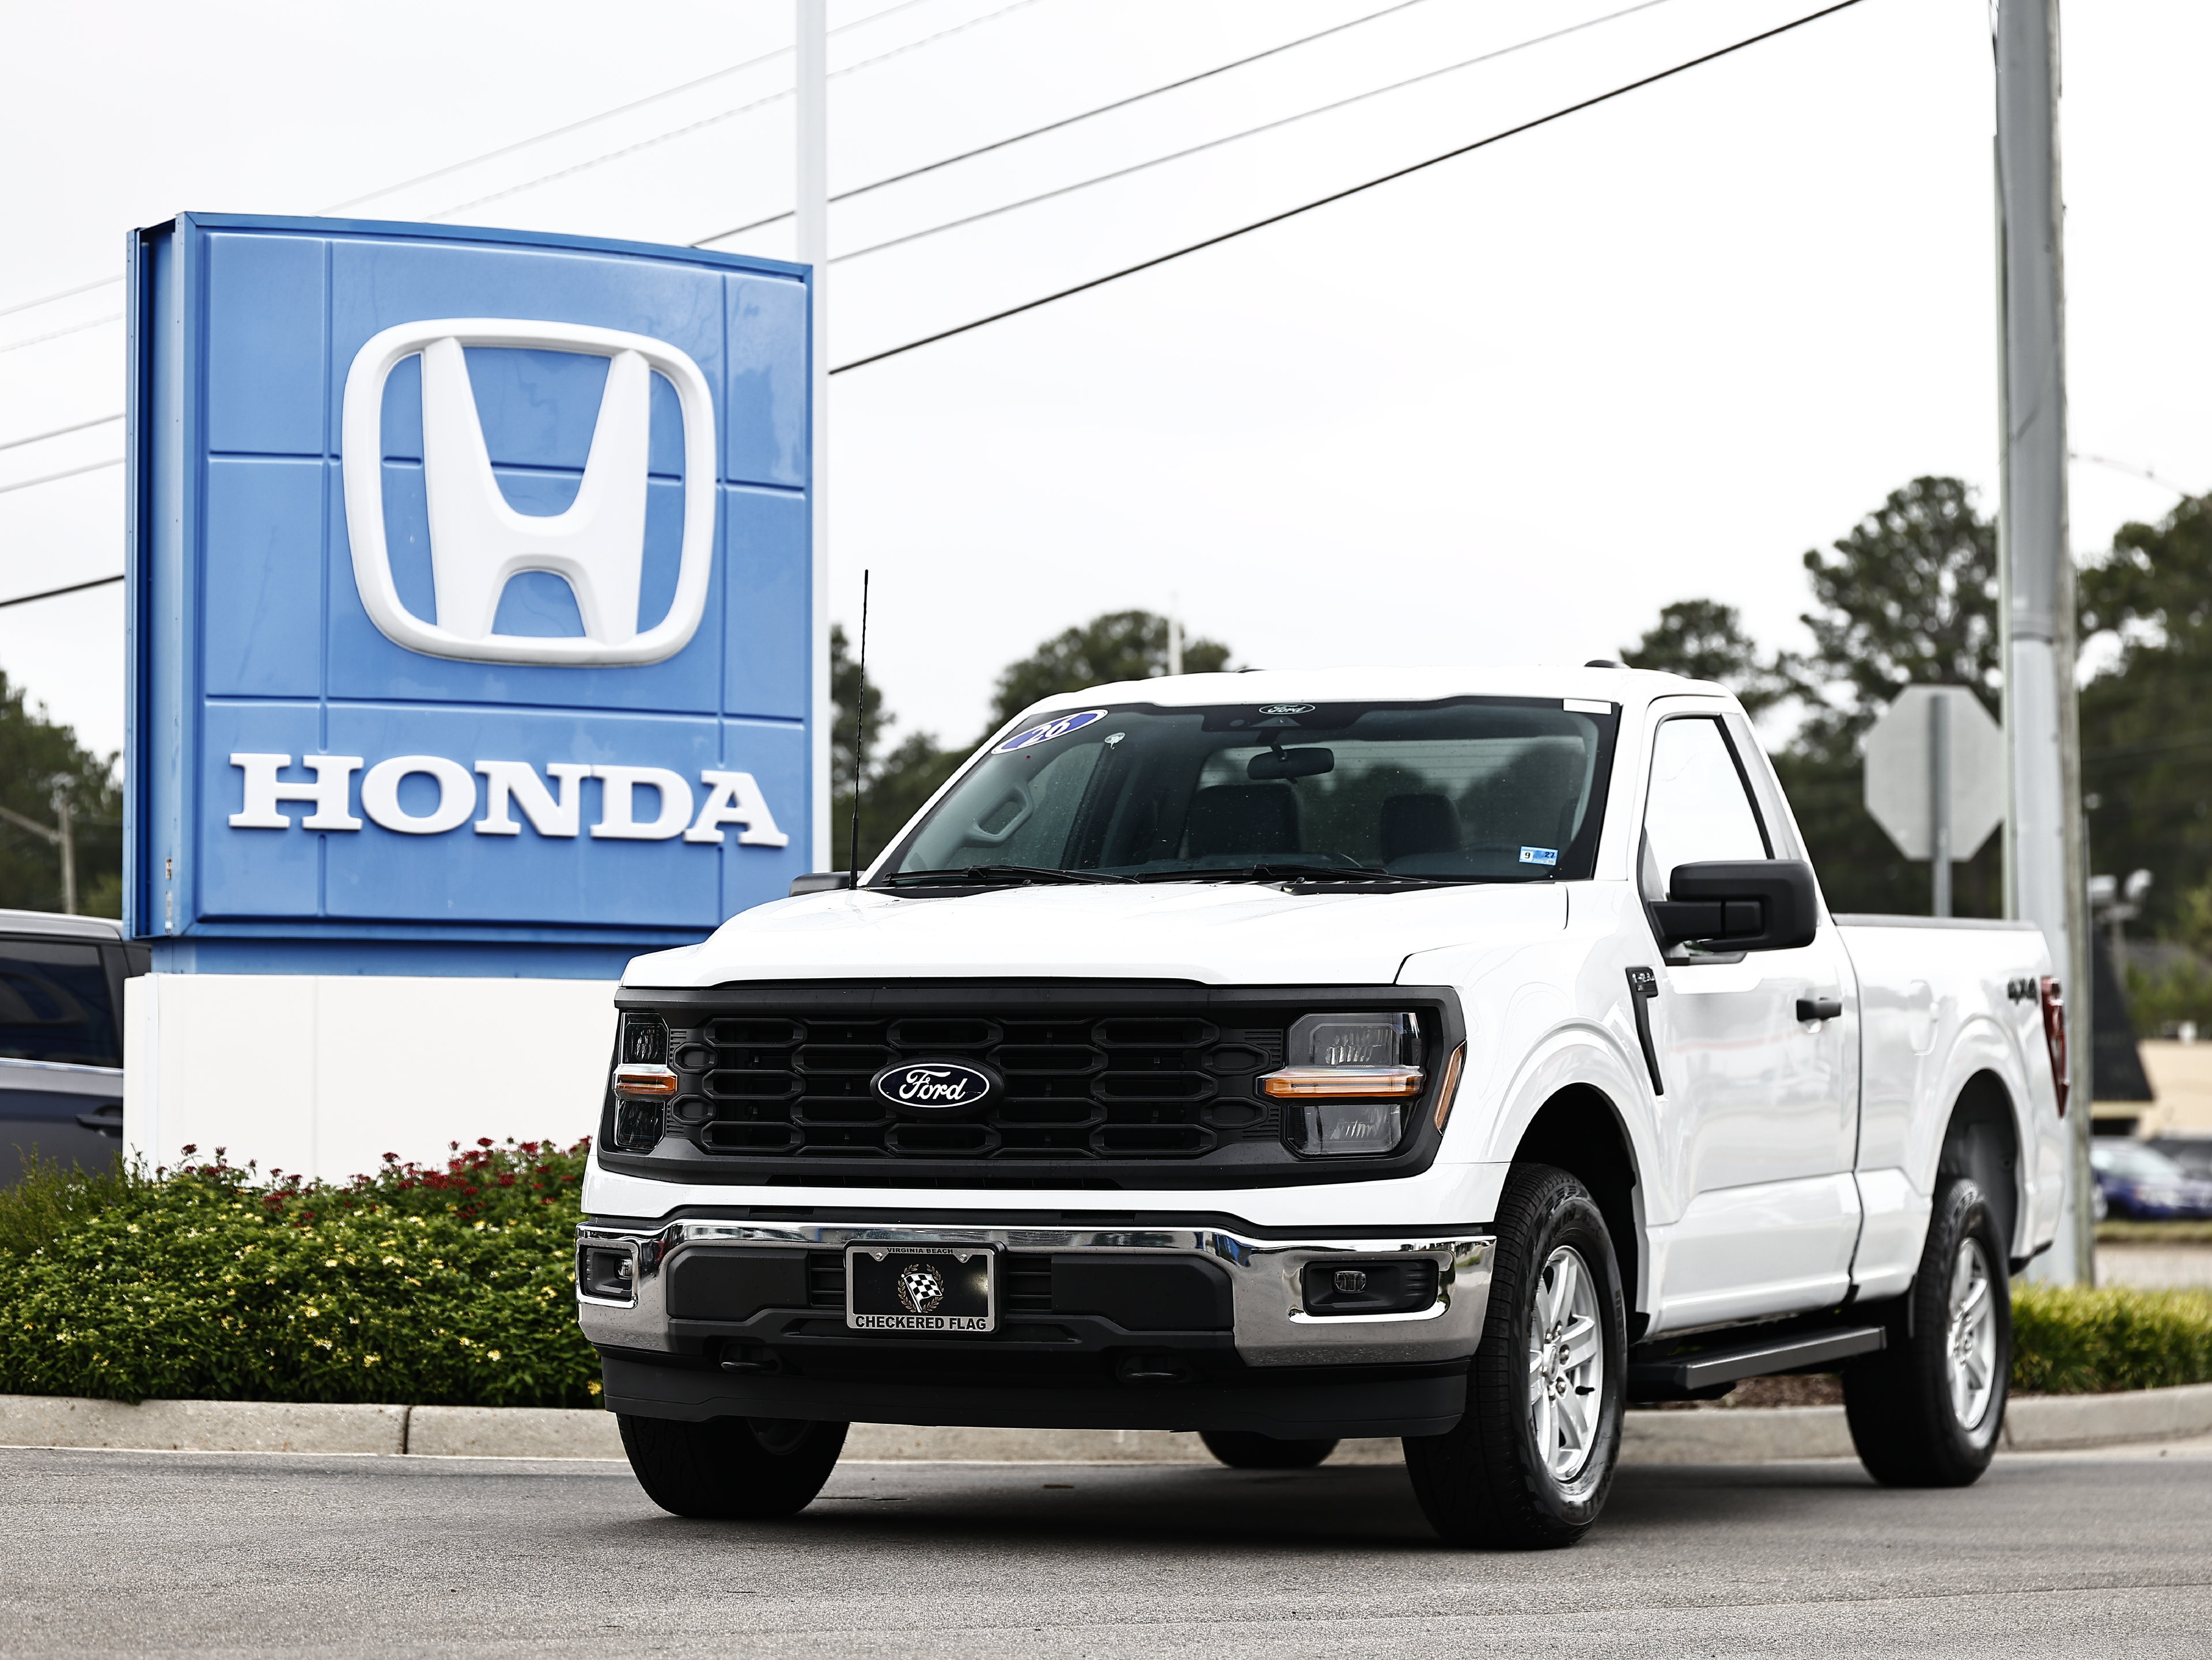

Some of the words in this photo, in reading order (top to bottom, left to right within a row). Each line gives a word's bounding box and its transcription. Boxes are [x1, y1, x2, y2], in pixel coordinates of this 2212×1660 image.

[1267, 703, 1306, 713] Ford
[1017, 713, 1081, 748] 26
[229, 752, 789, 847] HONDA
[899, 1069, 968, 1100] Ford
[855, 1316, 945, 1329] CHECKERED
[950, 1317, 987, 1331] FLAG
